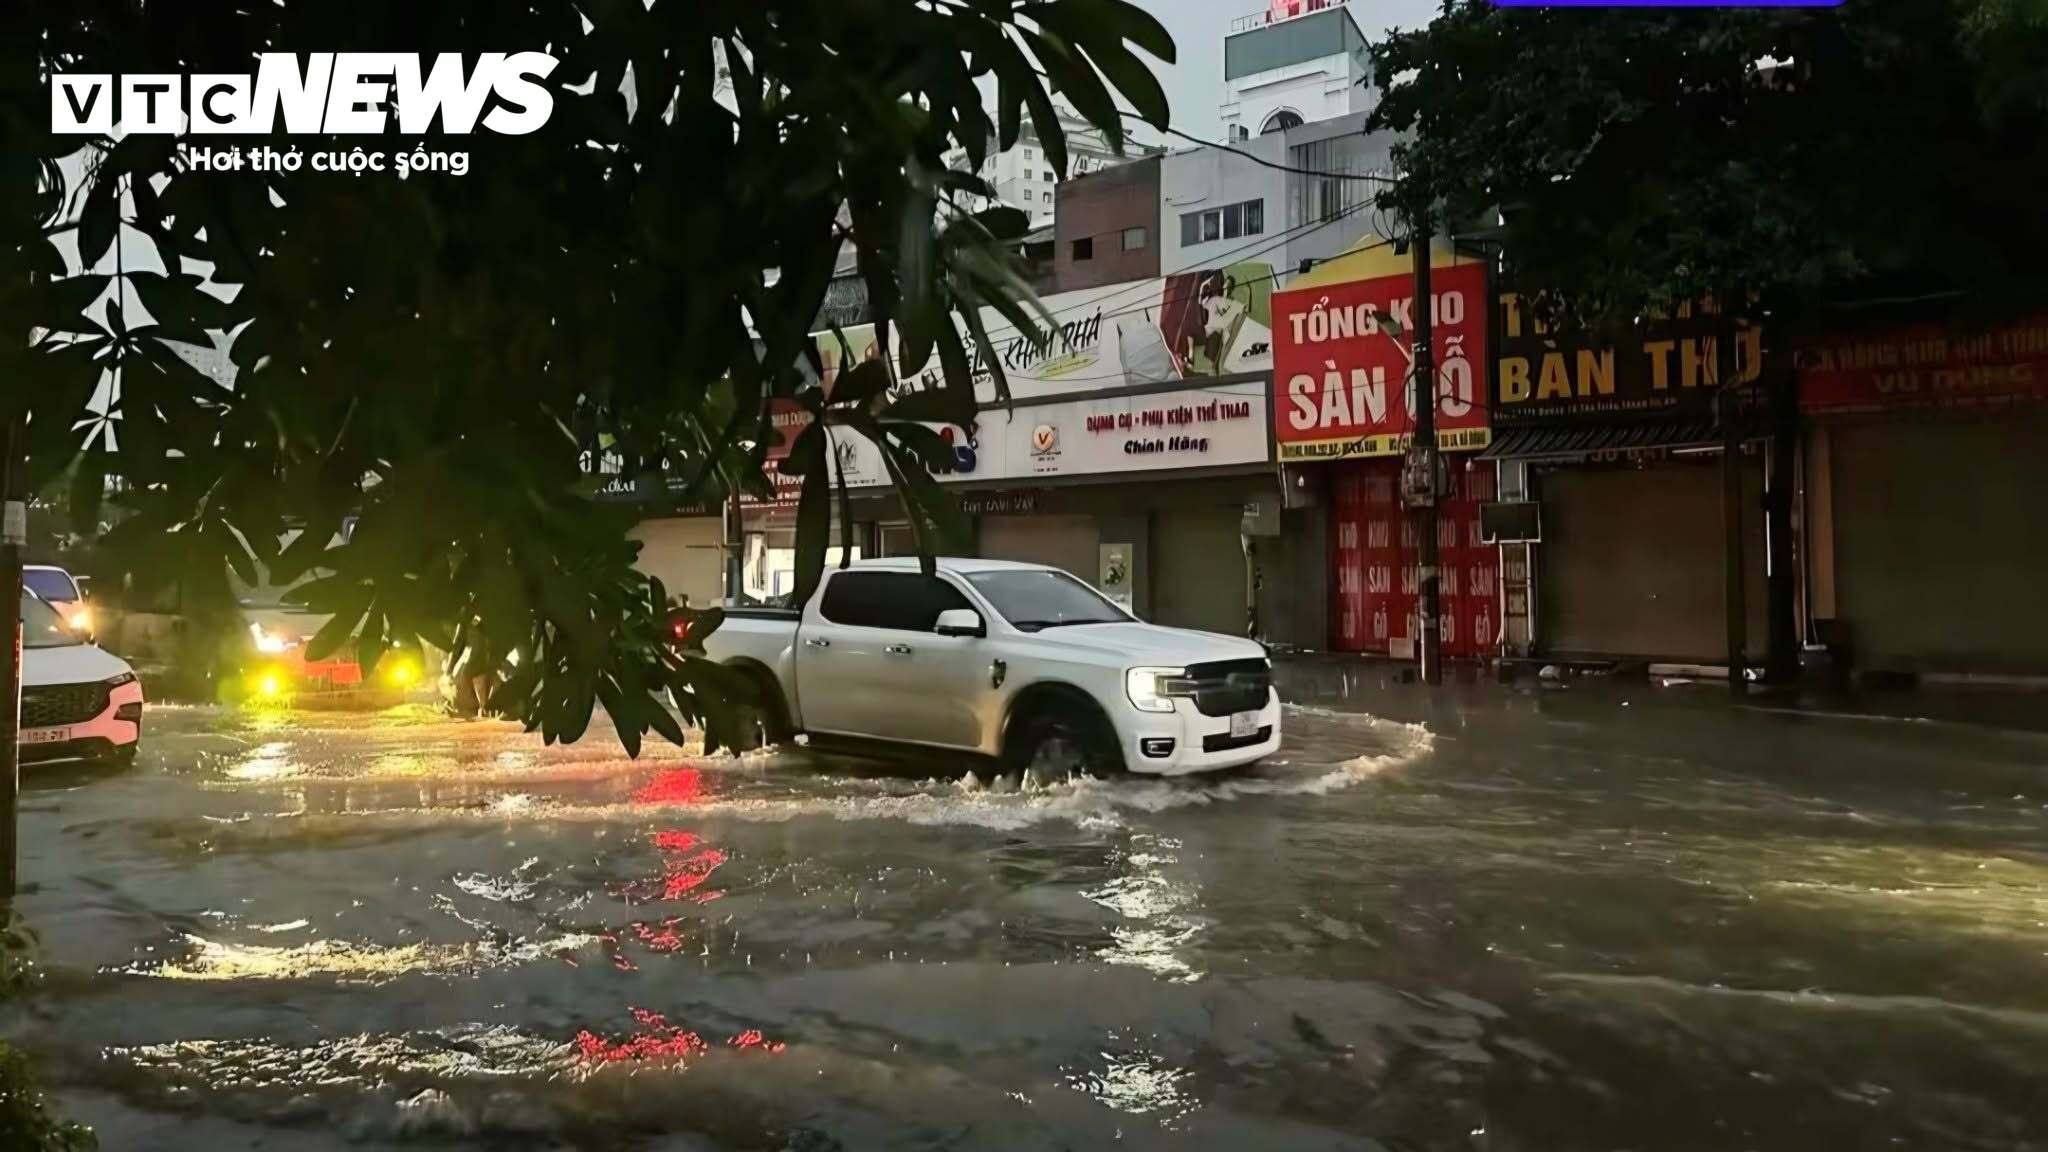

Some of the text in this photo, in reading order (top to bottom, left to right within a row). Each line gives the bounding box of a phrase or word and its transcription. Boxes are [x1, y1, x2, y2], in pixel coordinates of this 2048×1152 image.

[1289, 295, 1379, 345] TỔNG
[1288, 359, 1387, 430] SÀN
[1499, 338, 1616, 404] BÀN
[1220, 402, 1250, 420] THAO
